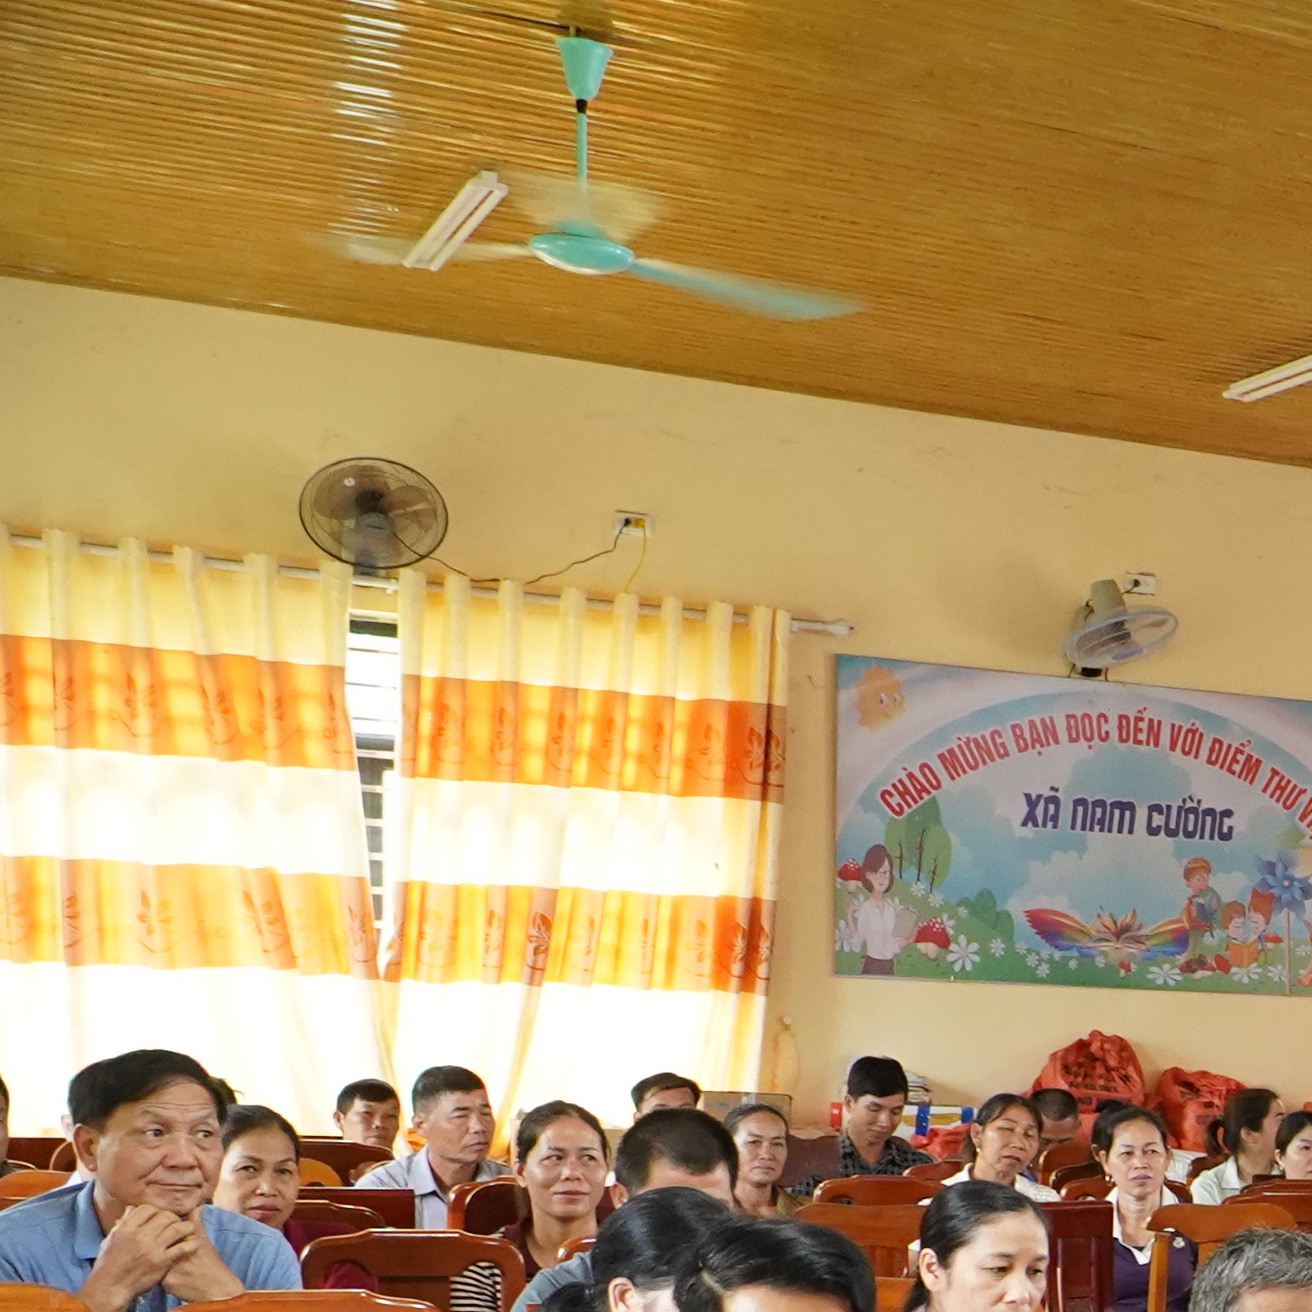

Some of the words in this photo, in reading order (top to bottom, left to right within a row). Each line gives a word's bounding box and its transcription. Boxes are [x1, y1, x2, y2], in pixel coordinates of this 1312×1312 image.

[879, 762, 943, 818] CHÀO
[937, 729, 1011, 782] MỪNG
[1010, 716, 1060, 756] BẠN
[1065, 712, 1110, 749] ĐỌC
[1117, 707, 1162, 748] ĐẾN
[1169, 722, 1204, 760] VỚI
[1206, 739, 1263, 785] ĐIỂM
[1261, 766, 1308, 811] THƯ
[1020, 786, 1060, 829] XÃ
